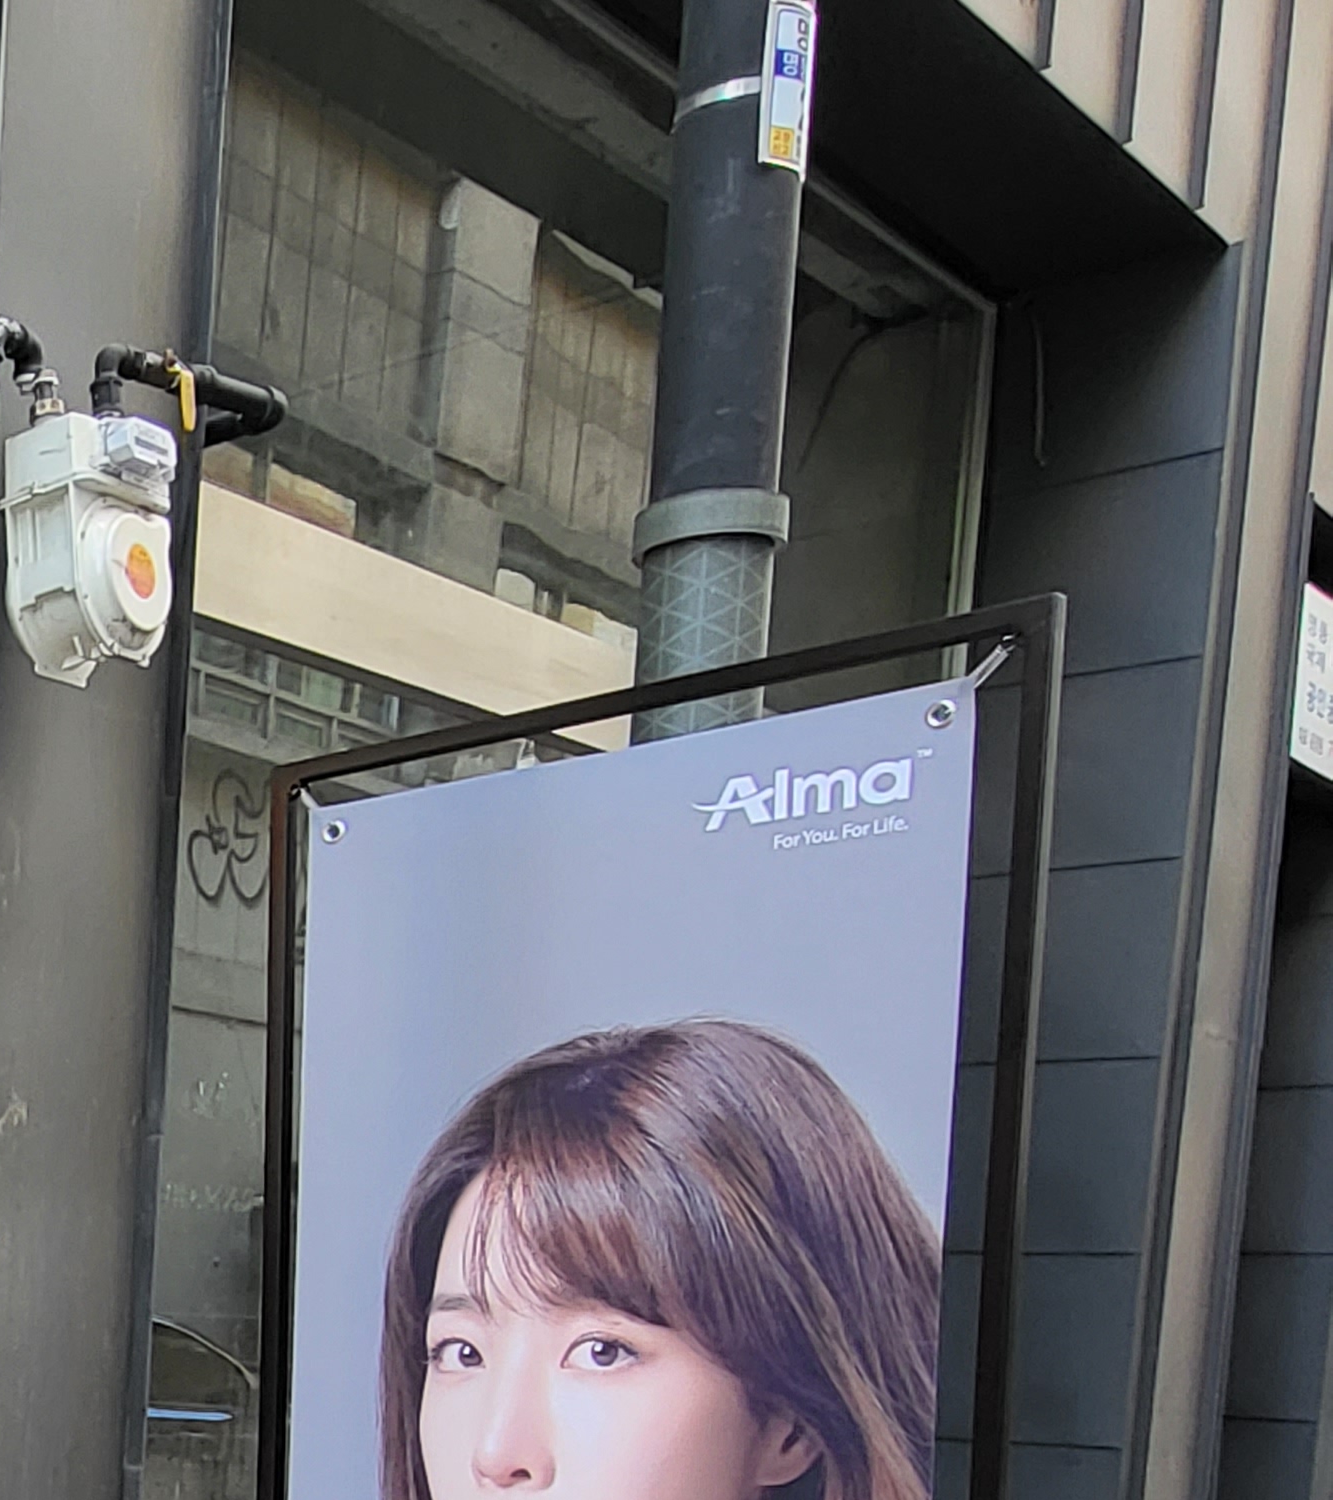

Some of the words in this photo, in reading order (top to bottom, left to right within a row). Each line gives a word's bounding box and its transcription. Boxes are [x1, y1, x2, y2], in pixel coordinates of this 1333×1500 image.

[773, 833, 800, 850] For
[801, 829, 838, 846] You.
[842, 823, 870, 840] For
[873, 815, 909, 835] Life.
